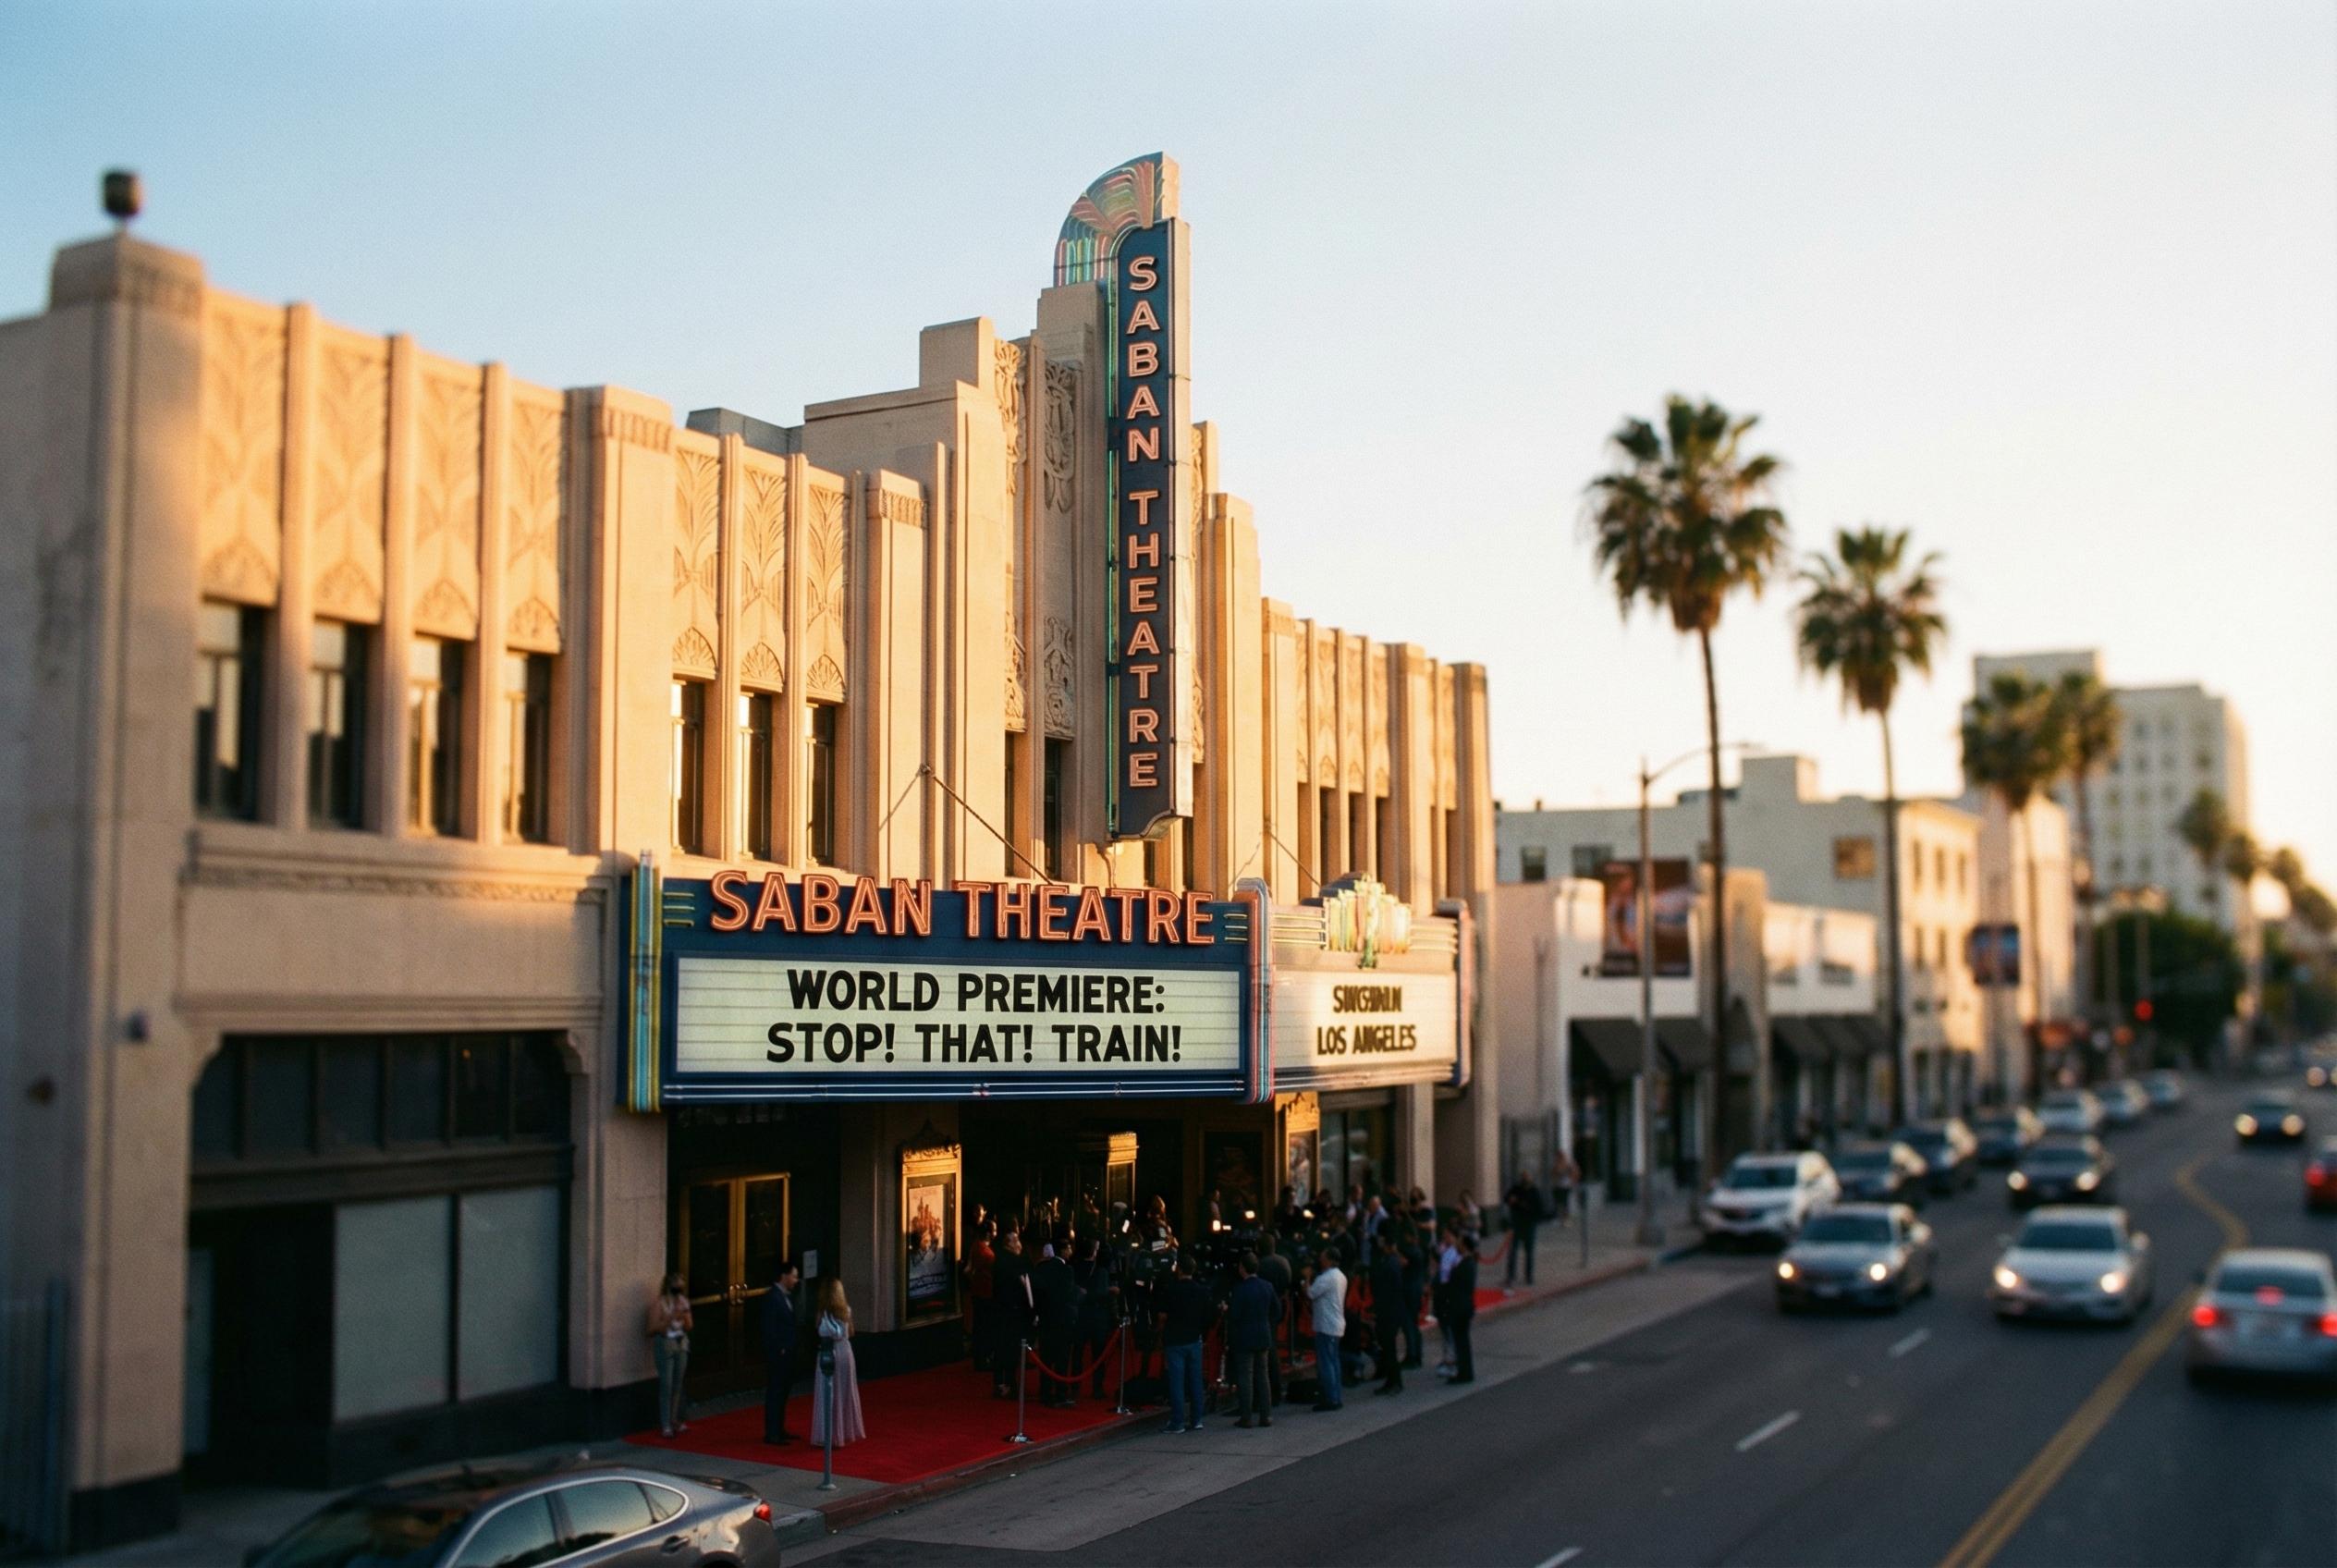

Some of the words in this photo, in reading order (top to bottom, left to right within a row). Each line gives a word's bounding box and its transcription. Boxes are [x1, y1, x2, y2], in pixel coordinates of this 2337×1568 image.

[1127, 254, 1161, 463] SABAN
[1127, 489, 1160, 789] THEATRE
[710, 870, 932, 936] SABAN
[953, 880, 1215, 945] THEATRE
[788, 969, 940, 1011] WORLD
[958, 974, 1165, 1014] PREMIERE:
[766, 1022, 896, 1063] STOP!
[915, 1023, 1034, 1063] THAT!
[1052, 1024, 1182, 1062] TRAIN!
[1316, 1025, 1347, 1055] LOS
